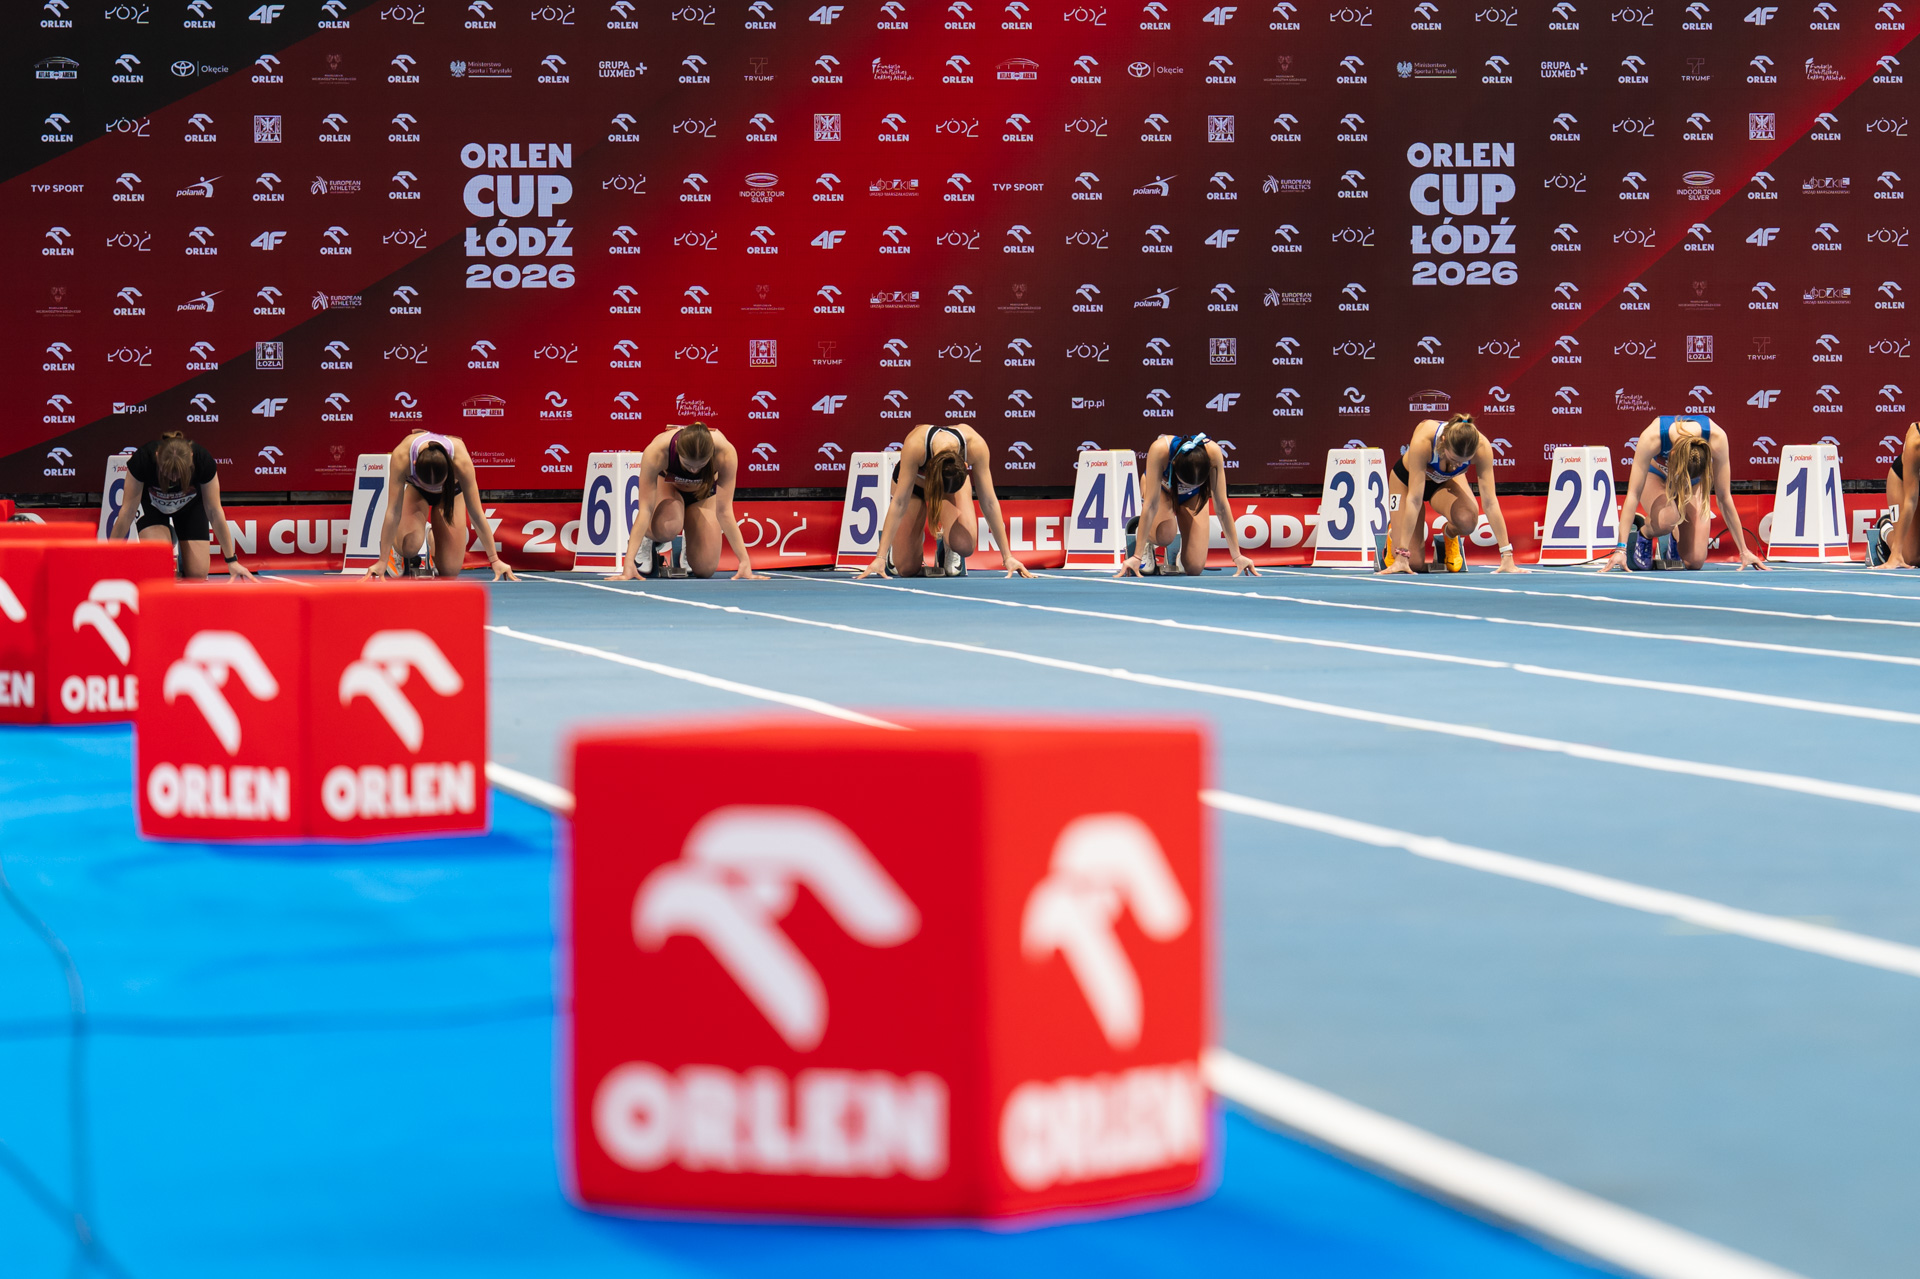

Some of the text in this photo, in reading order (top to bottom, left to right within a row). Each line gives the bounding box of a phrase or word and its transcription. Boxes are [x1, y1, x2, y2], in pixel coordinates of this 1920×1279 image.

[249, 5, 284, 23] 4F
[809, 6, 844, 24] 4F
[1203, 7, 1237, 25] 4F
[1744, 7, 1778, 25] 4F
[41, 20, 72, 28] ORLEN
[465, 21, 496, 29] ORLEN
[877, 22, 908, 30] ORLEN
[1140, 23, 1170, 31] ORLEN
[1411, 23, 1441, 31] ORLEN
[1810, 23, 1840, 31] ORLEN
[599, 61, 630, 69] GRUPA
[201, 66, 229, 74] Okęcie
[599, 70, 635, 78] LUXMED
[1157, 67, 1184, 75] Okęcie
[252, 76, 283, 84] ORLEN
[679, 76, 709, 84] ORLEN
[1071, 76, 1101, 84] ORLEN
[1482, 76, 1512, 84] ORLEN
[1747, 76, 1776, 84] ORLEN
[185, 135, 216, 143] ORLEN
[256, 134, 279, 142] PZLA
[816, 132, 839, 140] PZLA
[1003, 134, 1033, 142] ORLEN
[1210, 133, 1232, 141] PZLA
[1337, 134, 1367, 142] ORLEN
[1751, 131, 1773, 139] PZLA
[1811, 133, 1840, 141] ORLEN
[461, 143, 571, 168] ORLEN
[1407, 143, 1514, 167] ORLEN
[53, 185, 84, 193] SPORT
[1014, 183, 1044, 191] SPORT
[176, 189, 205, 197] polanik
[1133, 187, 1161, 196] polanik
[1410, 174, 1515, 215] CUP
[389, 192, 420, 200] ORLEN
[464, 175, 572, 217] CUP
[813, 194, 843, 202] ORLEN
[1207, 193, 1237, 201] ORLEN
[1748, 192, 1777, 200] ORLEN
[465, 219, 573, 256] ŁÓDŹ
[811, 231, 846, 249] 4F
[1205, 230, 1239, 248] 4F
[1411, 218, 1516, 254] ŁÓDŹ
[1746, 228, 1780, 246] 4F
[251, 232, 286, 250] 4F
[186, 248, 217, 256] ORLEN
[747, 247, 778, 255] ORLEN
[1142, 246, 1172, 254] ORLEN
[1684, 244, 1714, 252] ORLEN
[466, 264, 575, 288] 2026
[1413, 261, 1517, 285] 2026
[177, 303, 206, 312] polanik
[1134, 300, 1162, 309] polanik
[1339, 304, 1369, 312] ORLEN
[1749, 302, 1778, 310] ORLEN
[114, 308, 145, 316] ORLEN
[610, 306, 640, 314] ORLEN
[944, 306, 975, 314] ORLEN
[1211, 356, 1234, 364] ŁOZLA
[1414, 357, 1444, 365] ORLEN
[1688, 353, 1710, 361] ŁOZLA
[257, 360, 281, 368] ŁOZLA
[610, 361, 641, 369] ORLEN
[751, 358, 774, 366] ŁOZLA
[1004, 359, 1035, 367] ORLEN
[186, 363, 218, 371] ORLEN
[1206, 393, 1240, 412] 4F
[1747, 390, 1781, 408] 4F
[252, 398, 288, 417] 4F
[812, 395, 847, 414] 4F
[1273, 409, 1303, 417] ORLEN
[1685, 406, 1715, 414] ORLEN
[611, 412, 641, 420] ORLEN
[945, 411, 976, 419] ORLEN
[43, 416, 75, 424] ORLEN
[1750, 457, 1779, 465] ORLEN
[1793, 454, 1813, 462] polanik
[1876, 455, 1898, 463] ORL
[749, 464, 779, 472] ORLEN
[861, 461, 879, 469] polanik
[1091, 460, 1108, 468] polanik
[1224, 461, 1239, 469] LEN
[44, 469, 75, 477] ORLEN
[1121, 473, 1136, 529] 4
[1368, 471, 1387, 534] 3
[1390, 495, 1398, 510] 3
[1552, 470, 1582, 538] 2
[1593, 470, 1614, 538] 2
[1786, 467, 1808, 537] 1
[1825, 467, 1839, 536] 1
[850, 475, 879, 544] 5
[1077, 473, 1108, 543] 4
[1327, 471, 1355, 540] 3
[359, 477, 384, 547] 7
[587, 475, 612, 545] 6
[1890, 507, 1897, 522] 1
[978, 517, 1071, 551] RLE
[61, 675, 138, 713] ORLE
[147, 763, 290, 821] ORLEN
[322, 761, 475, 820] ORLEN
[593, 1064, 948, 1177] ORLEN
[1000, 1062, 1204, 1190] ORLEN
